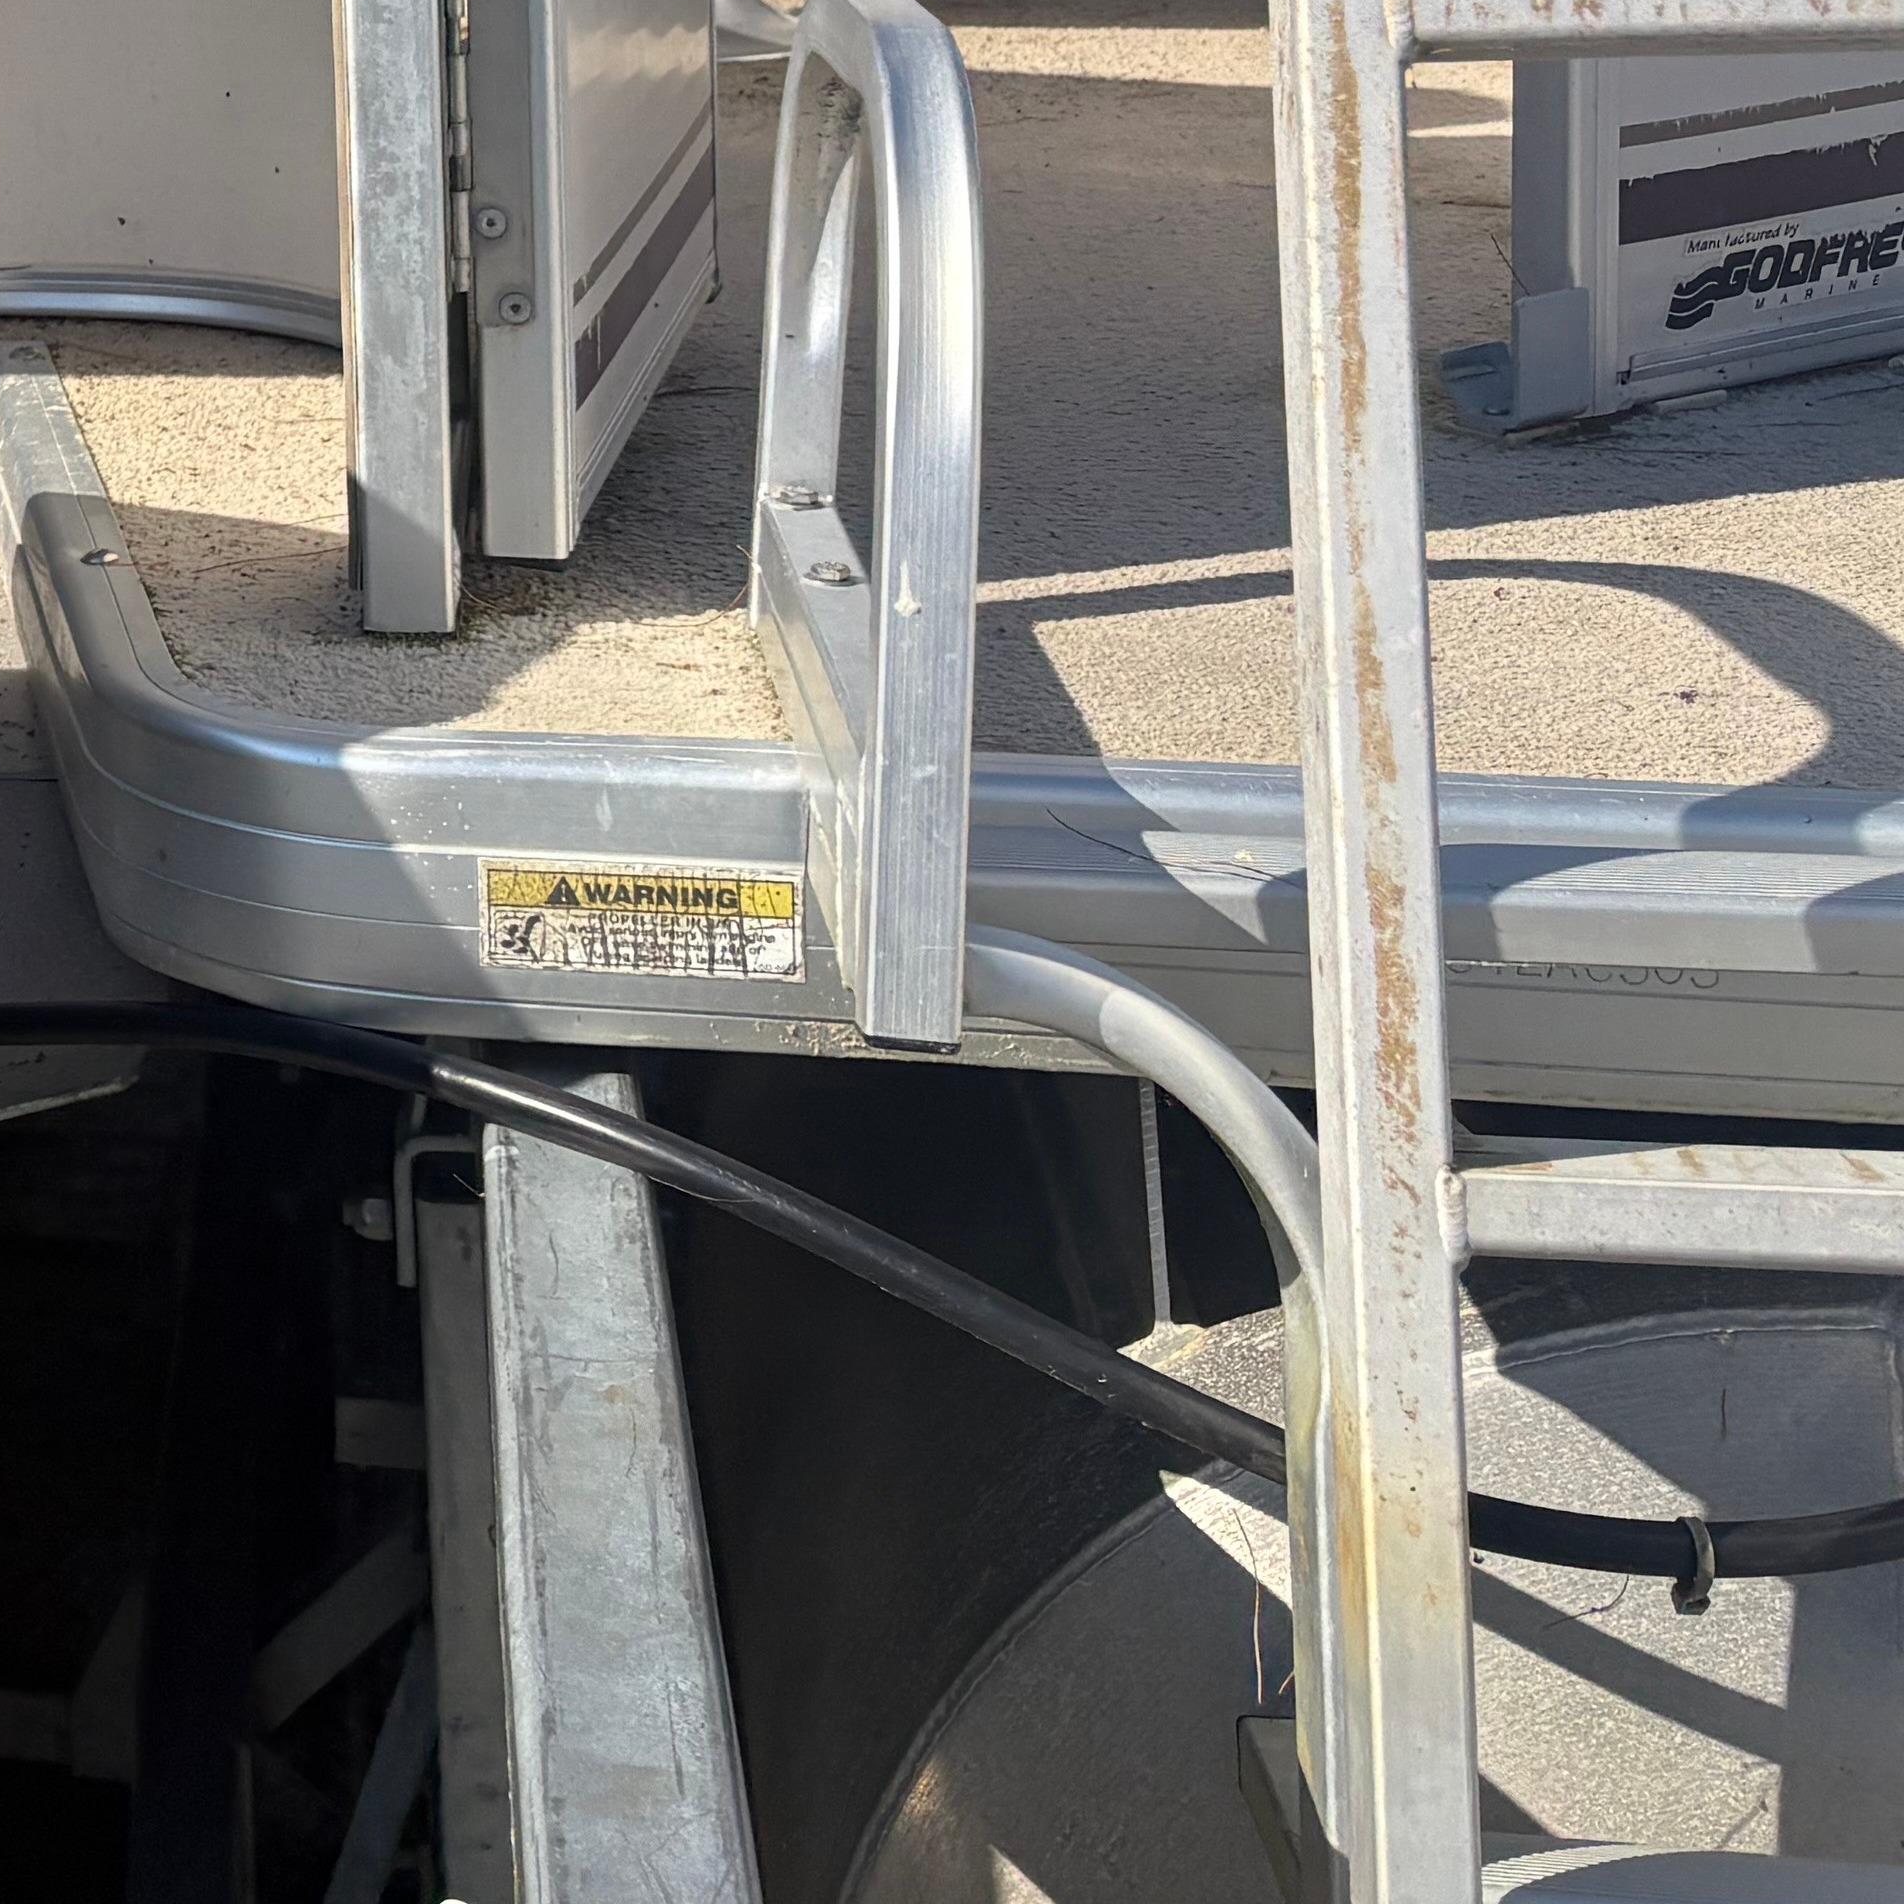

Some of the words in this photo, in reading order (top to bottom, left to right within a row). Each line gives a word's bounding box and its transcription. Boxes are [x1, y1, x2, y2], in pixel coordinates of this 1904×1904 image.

[1784, 222, 1800, 237] by
[1718, 222, 1904, 300] GODFRE
[1754, 274, 1881, 309] MARINE
[585, 881, 739, 909] WARNING
